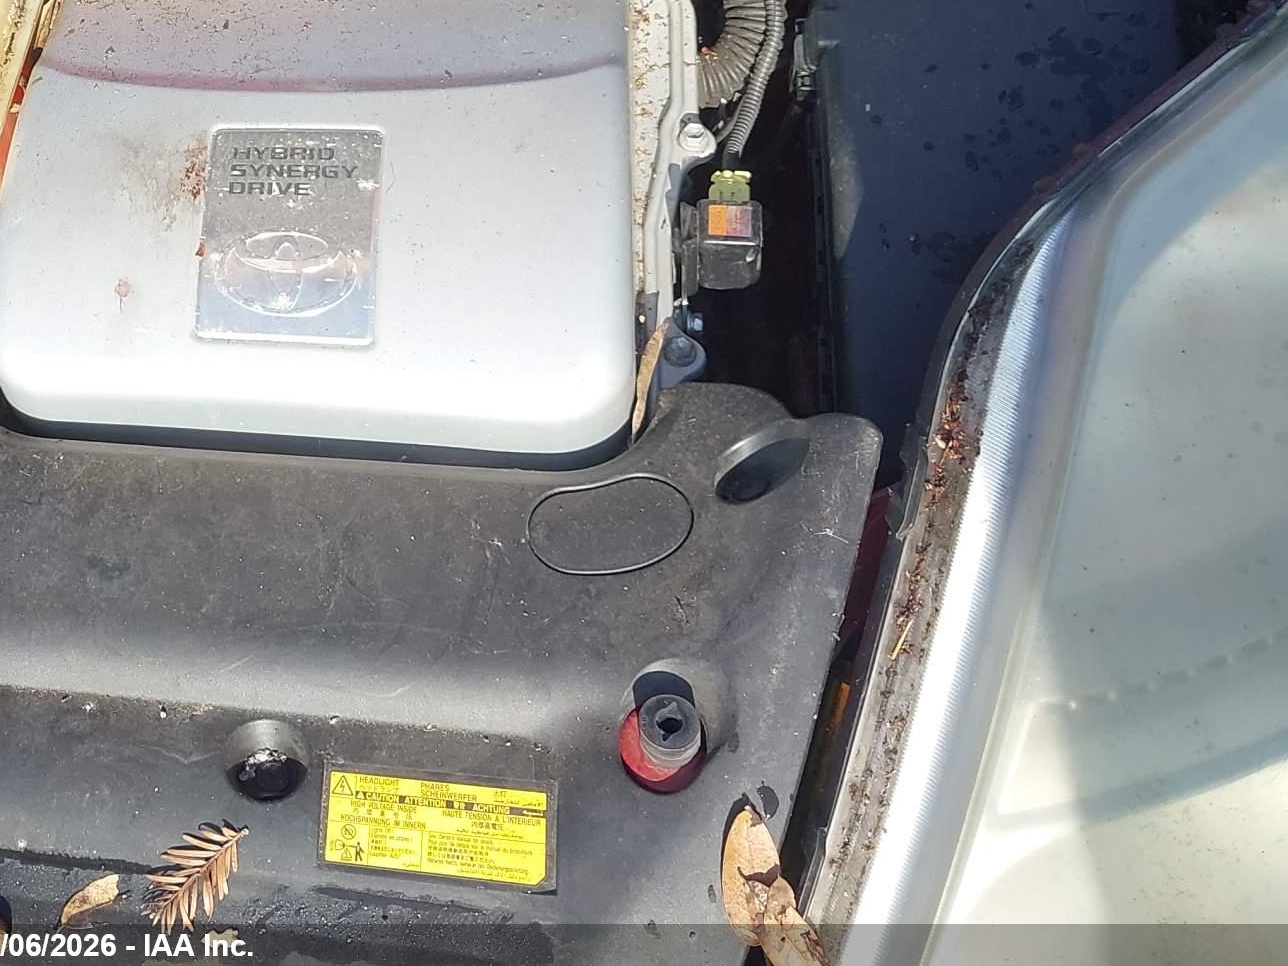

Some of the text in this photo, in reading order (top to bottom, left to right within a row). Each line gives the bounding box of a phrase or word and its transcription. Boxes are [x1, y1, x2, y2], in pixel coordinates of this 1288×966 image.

[232, 145, 336, 161] HYBRID
[229, 163, 359, 179] SYNERGY
[228, 181, 311, 196] DRIVE
[359, 775, 400, 786] HEADLIGHT
[420, 782, 450, 792] PHARES
[420, 790, 478, 802] SCHEINWERFER
[365, 792, 400, 804] CAUTION
[403, 796, 447, 807] ATTENTION
[472, 803, 511, 815] ACHTUNG
[368, 801, 394, 811] VOLTAGE
[397, 805, 417, 814] INSIDE
[442, 809, 463, 819] HAUTE
[465, 811, 492, 822] TENSION
